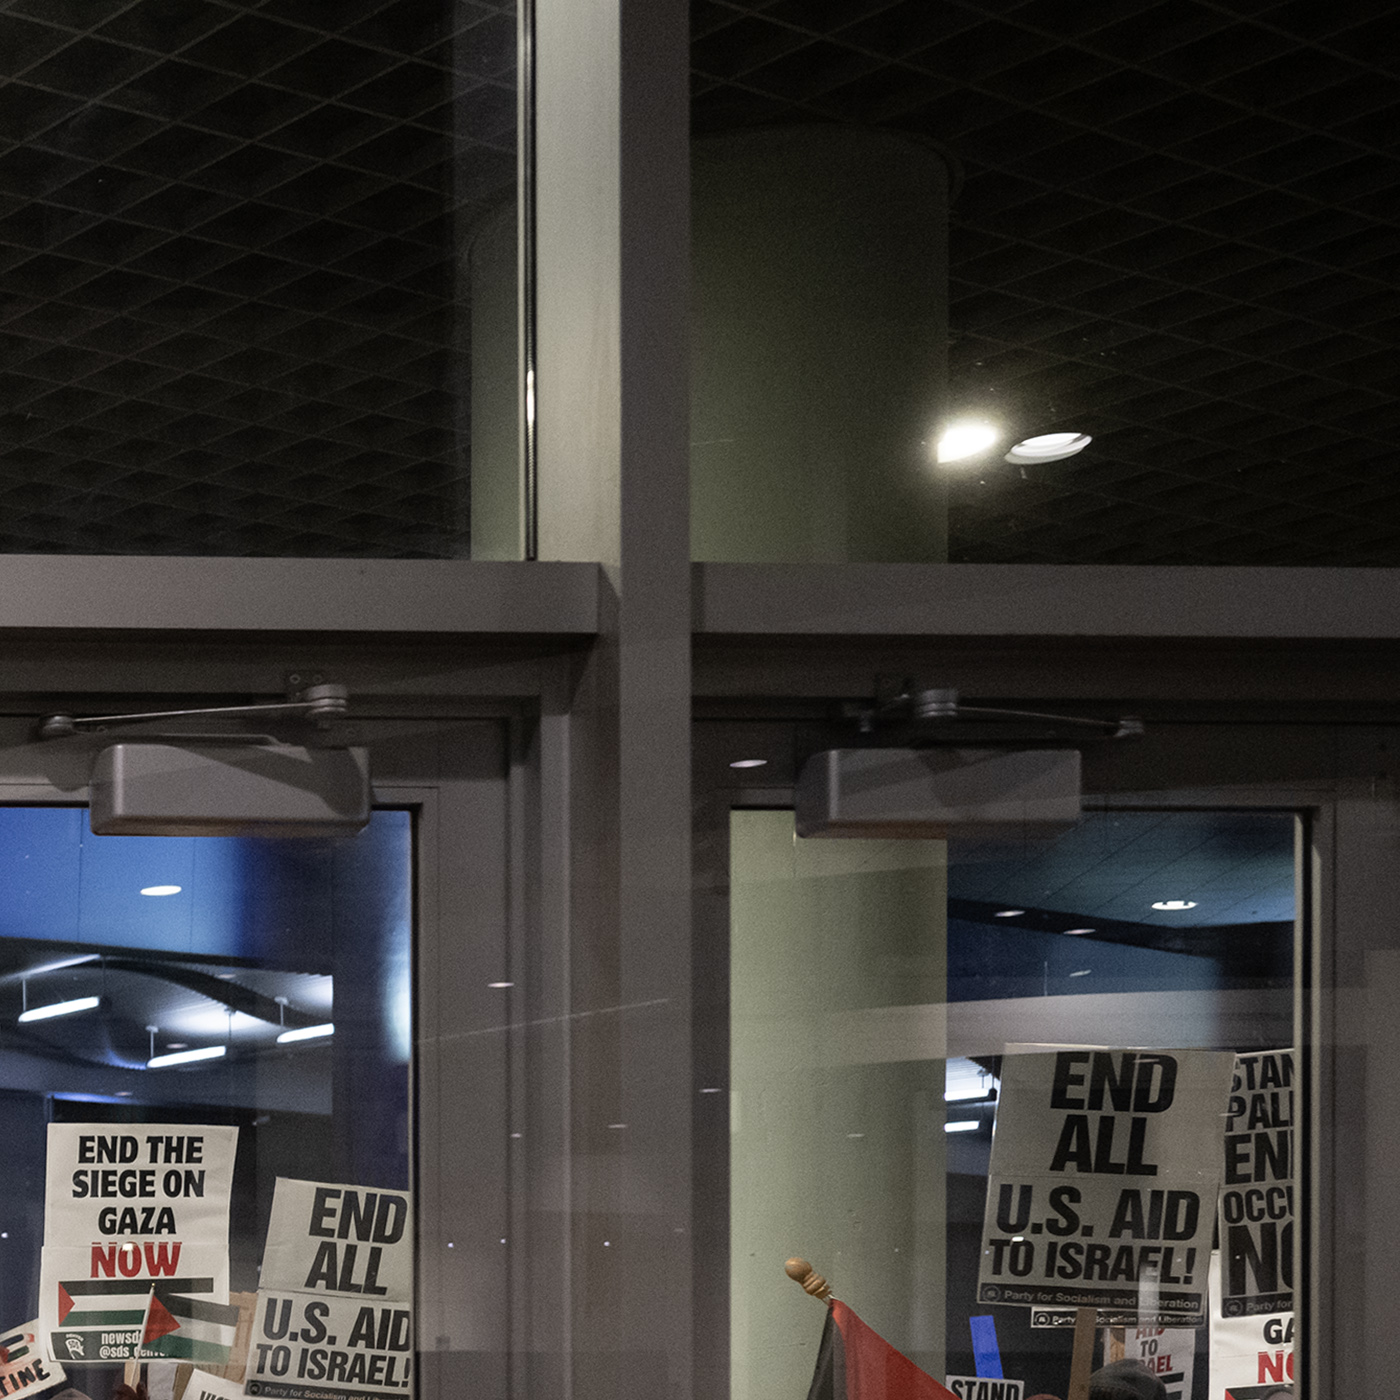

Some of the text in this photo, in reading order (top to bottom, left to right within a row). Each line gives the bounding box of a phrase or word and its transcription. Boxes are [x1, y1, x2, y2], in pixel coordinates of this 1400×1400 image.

[1051, 1052, 1178, 1113] END
[78, 1135, 204, 1163] END THE
[1050, 1114, 1158, 1176] ALL
[72, 1170, 205, 1198] SIEGE ON
[98, 1207, 176, 1235] GAZA
[309, 1187, 408, 1245] END
[996, 1184, 1200, 1241] U.S. AID
[91, 1242, 182, 1278] NOW
[304, 1241, 387, 1295] ALL
[990, 1239, 1197, 1284] TO ISRAEL!
[1004, 1291, 1034, 1302] Party
[1037, 1292, 1053, 1301] for
[1056, 1293, 1111, 1304] Socialism
[1114, 1296, 1136, 1305] and
[1246, 1302, 1275, 1311] Party
[263, 1298, 410, 1352] U.S. AID
[1264, 1317, 1294, 1344] GA
[256, 1343, 411, 1388] TO ISRAEL!
[1141, 1339, 1158, 1357] TO
[264, 1387, 288, 1397] Party
[290, 1389, 302, 1397] for
[305, 1390, 346, 1400] Socialism
